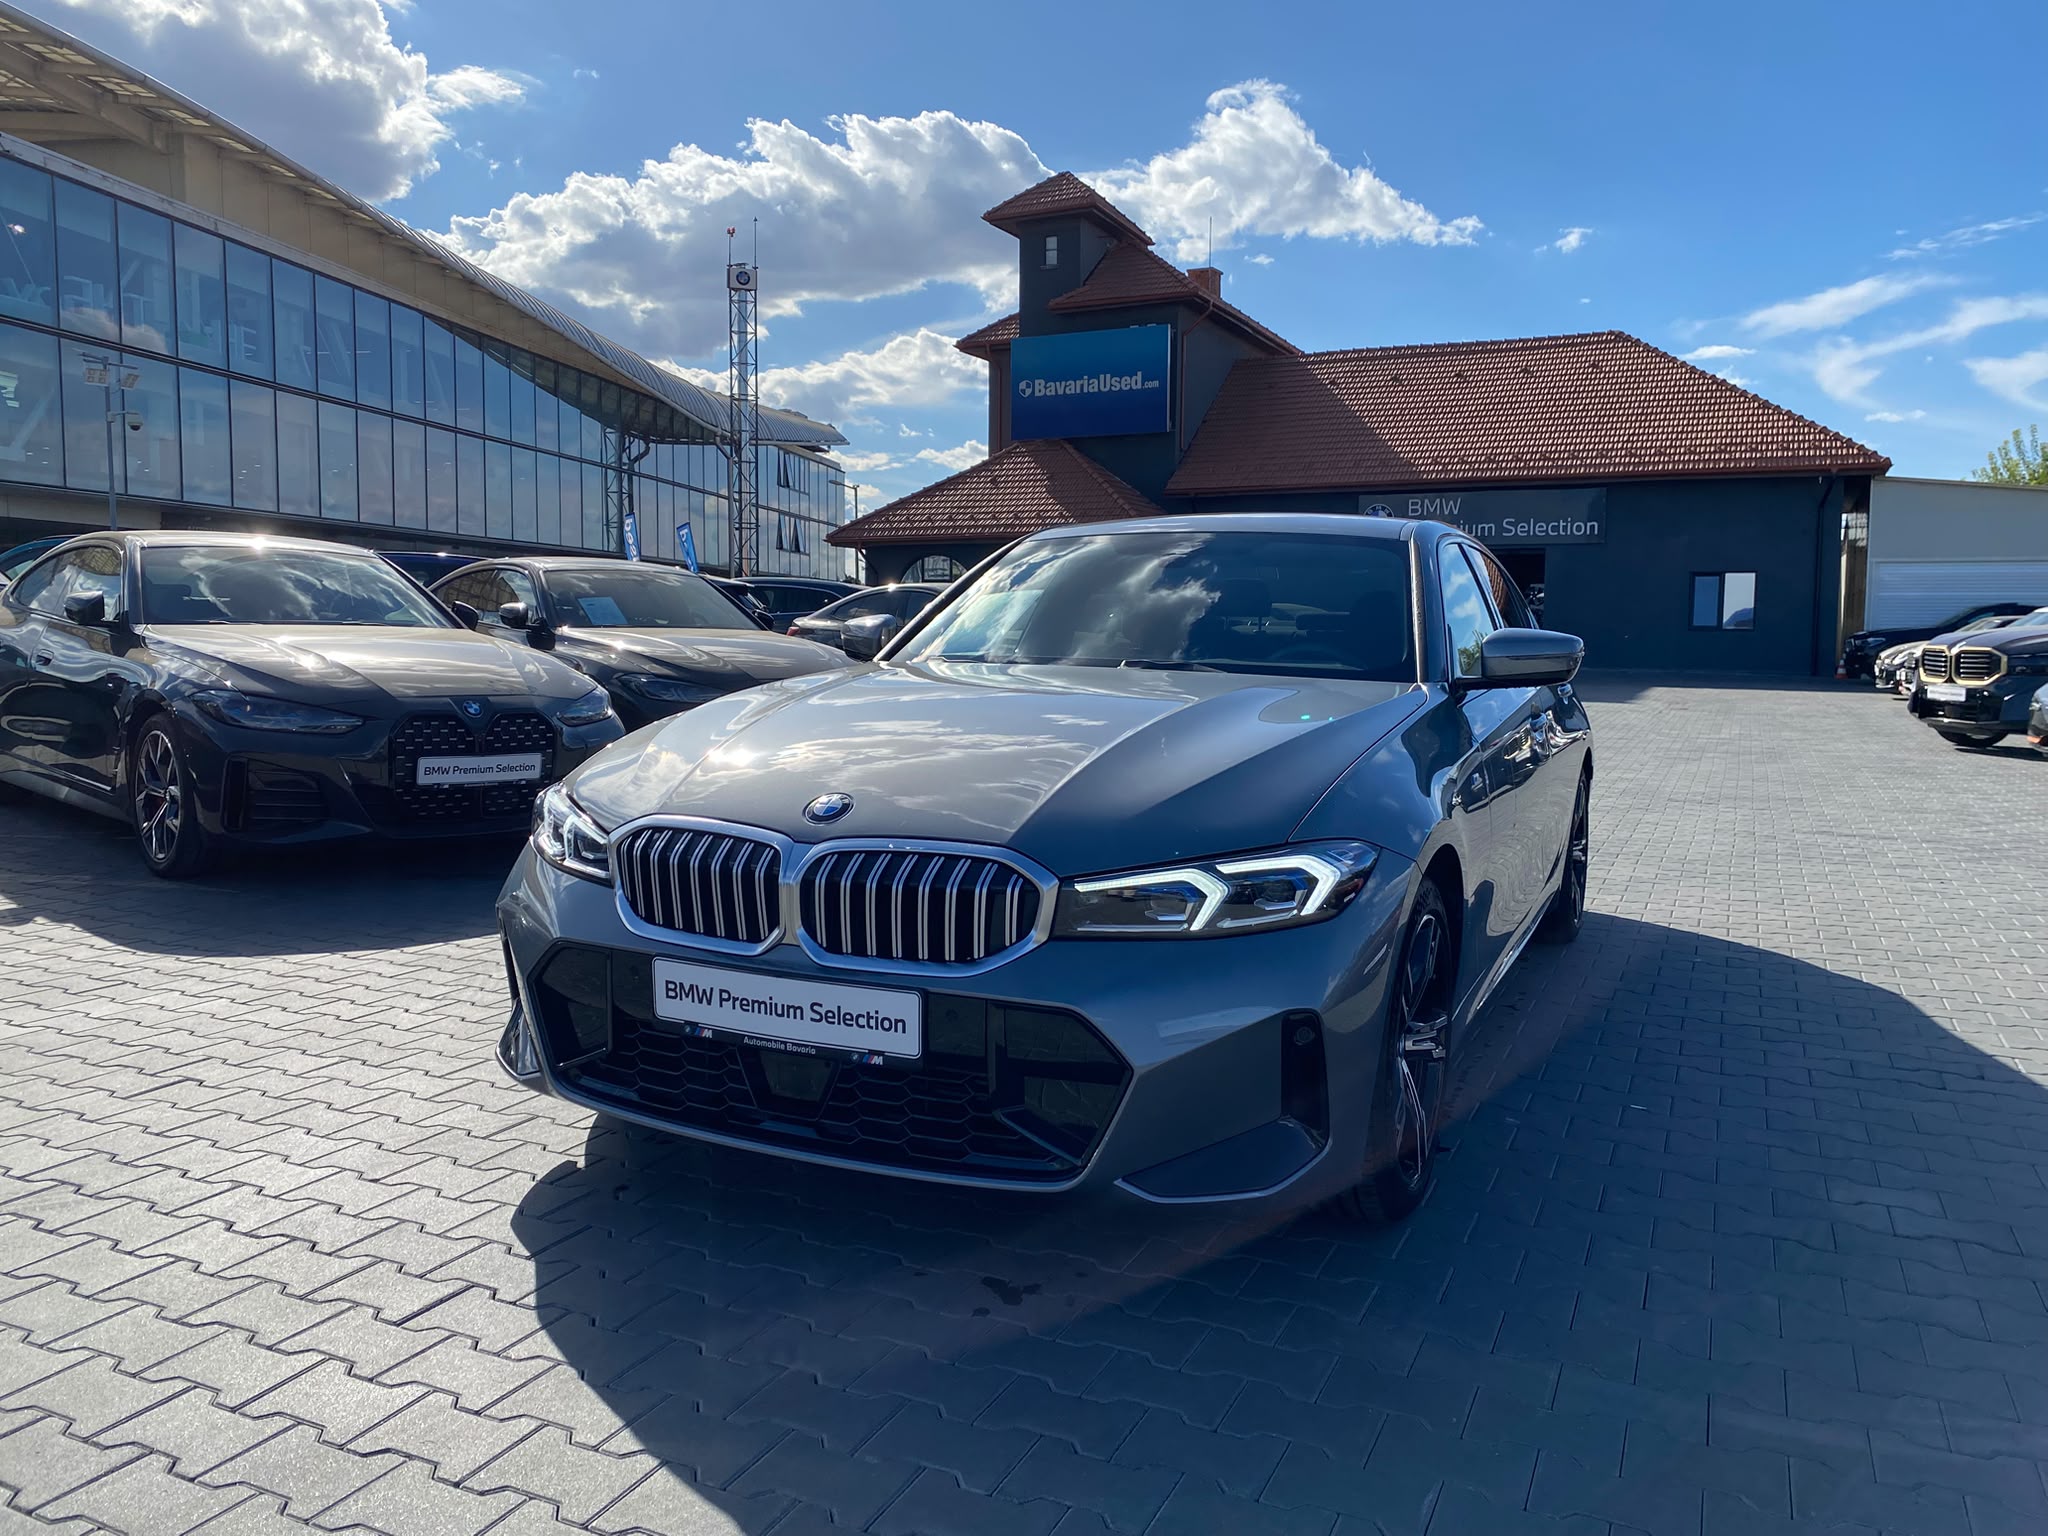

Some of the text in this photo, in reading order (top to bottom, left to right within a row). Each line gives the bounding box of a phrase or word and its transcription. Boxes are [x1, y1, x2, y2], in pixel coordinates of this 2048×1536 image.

[1034, 371, 1160, 397] BavariaUsed.com
[1408, 497, 1462, 517] BMW
[1502, 517, 1599, 538] Selection
[424, 762, 536, 776] BMW Premium Selection
[665, 979, 907, 1035] BMW Premium Selection
[743, 1036, 816, 1056] Automobile Bavaria
